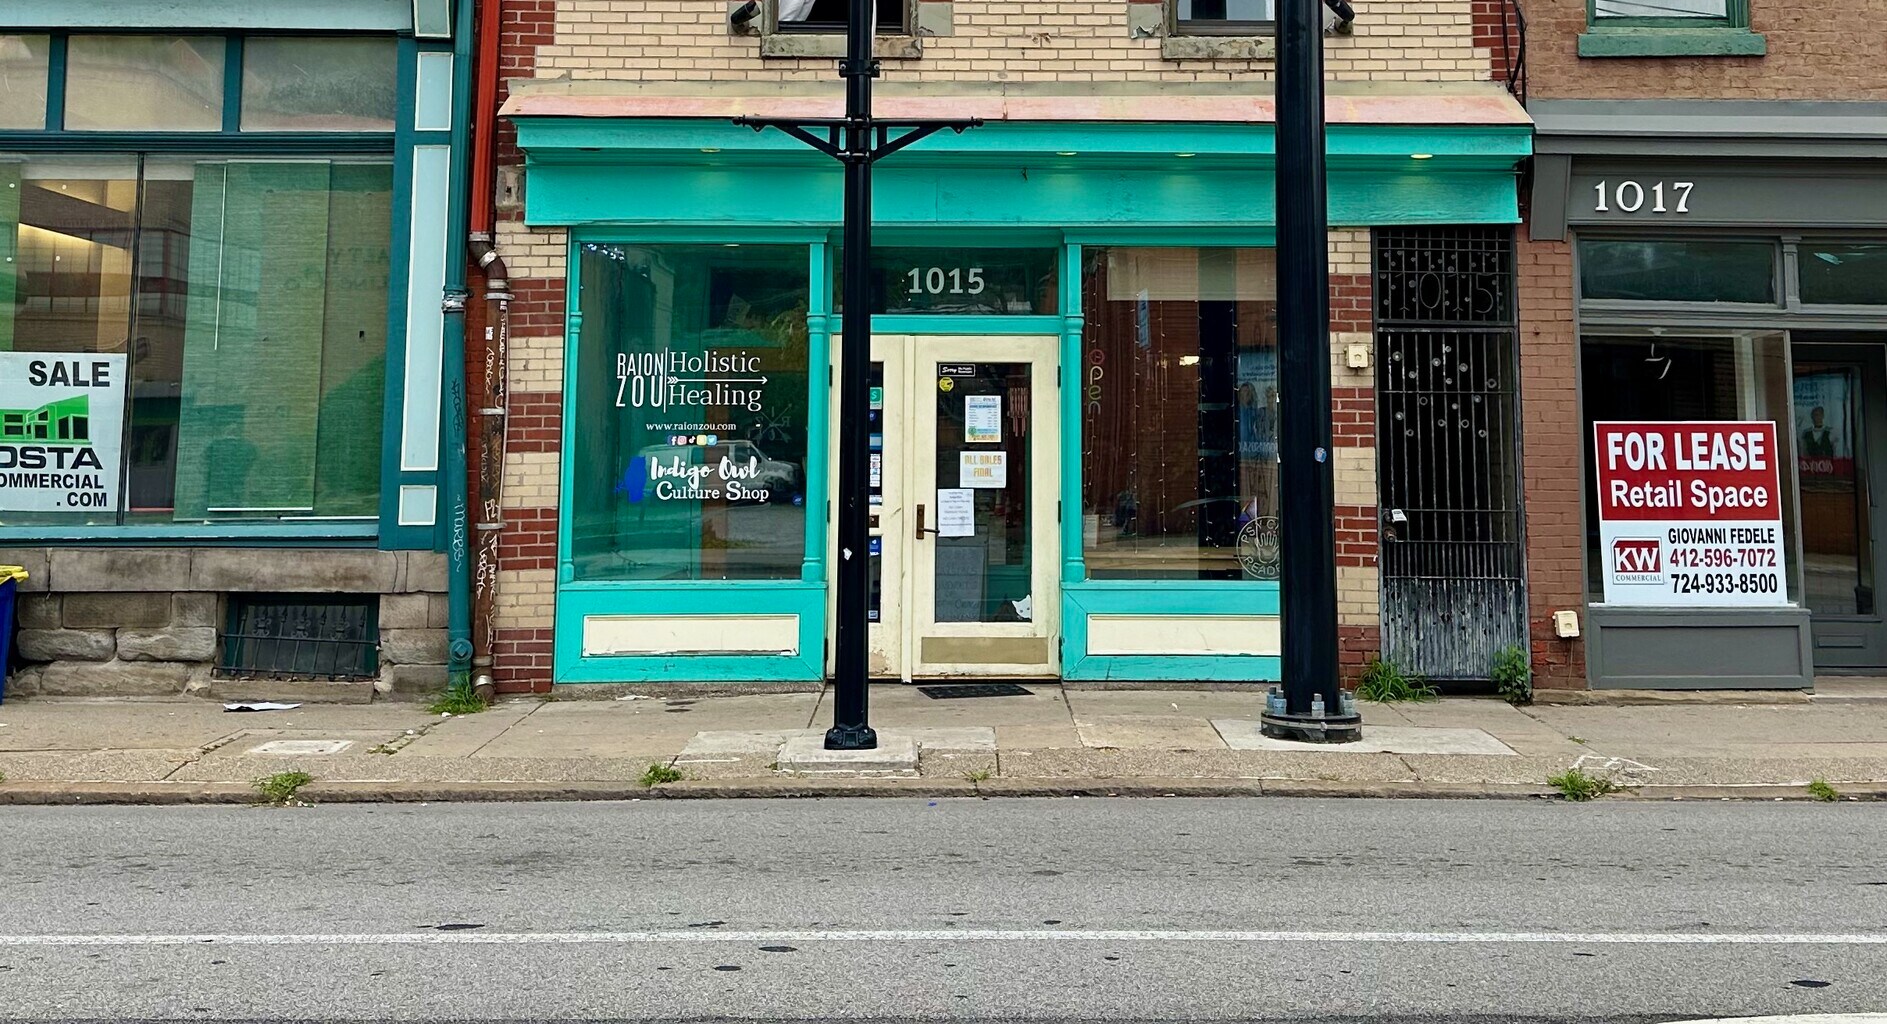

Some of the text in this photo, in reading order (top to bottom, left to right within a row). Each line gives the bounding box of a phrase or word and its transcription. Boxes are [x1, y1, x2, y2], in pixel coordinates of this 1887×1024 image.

[1594, 180, 1694, 213] 1017
[907, 267, 985, 294] 1015
[28, 360, 111, 387] SALE
[616, 352, 664, 376] RAION
[669, 350, 761, 373] Holistic
[615, 375, 663, 407] ZOU
[668, 383, 762, 412] Healing
[645, 422, 737, 431] www.raionzou.com
[1607, 432, 1766, 471] FOR LEASE
[650, 455, 761, 489] Indigo Owl
[656, 481, 769, 501] Culture Shop
[1610, 479, 1768, 514] Retail Space
[1668, 528, 1775, 544] GIOVANNI FEDELE
[1614, 547, 1659, 571] KW
[1669, 548, 1776, 568] 412-596-7072
[1670, 573, 1778, 594] 724-933-8500
